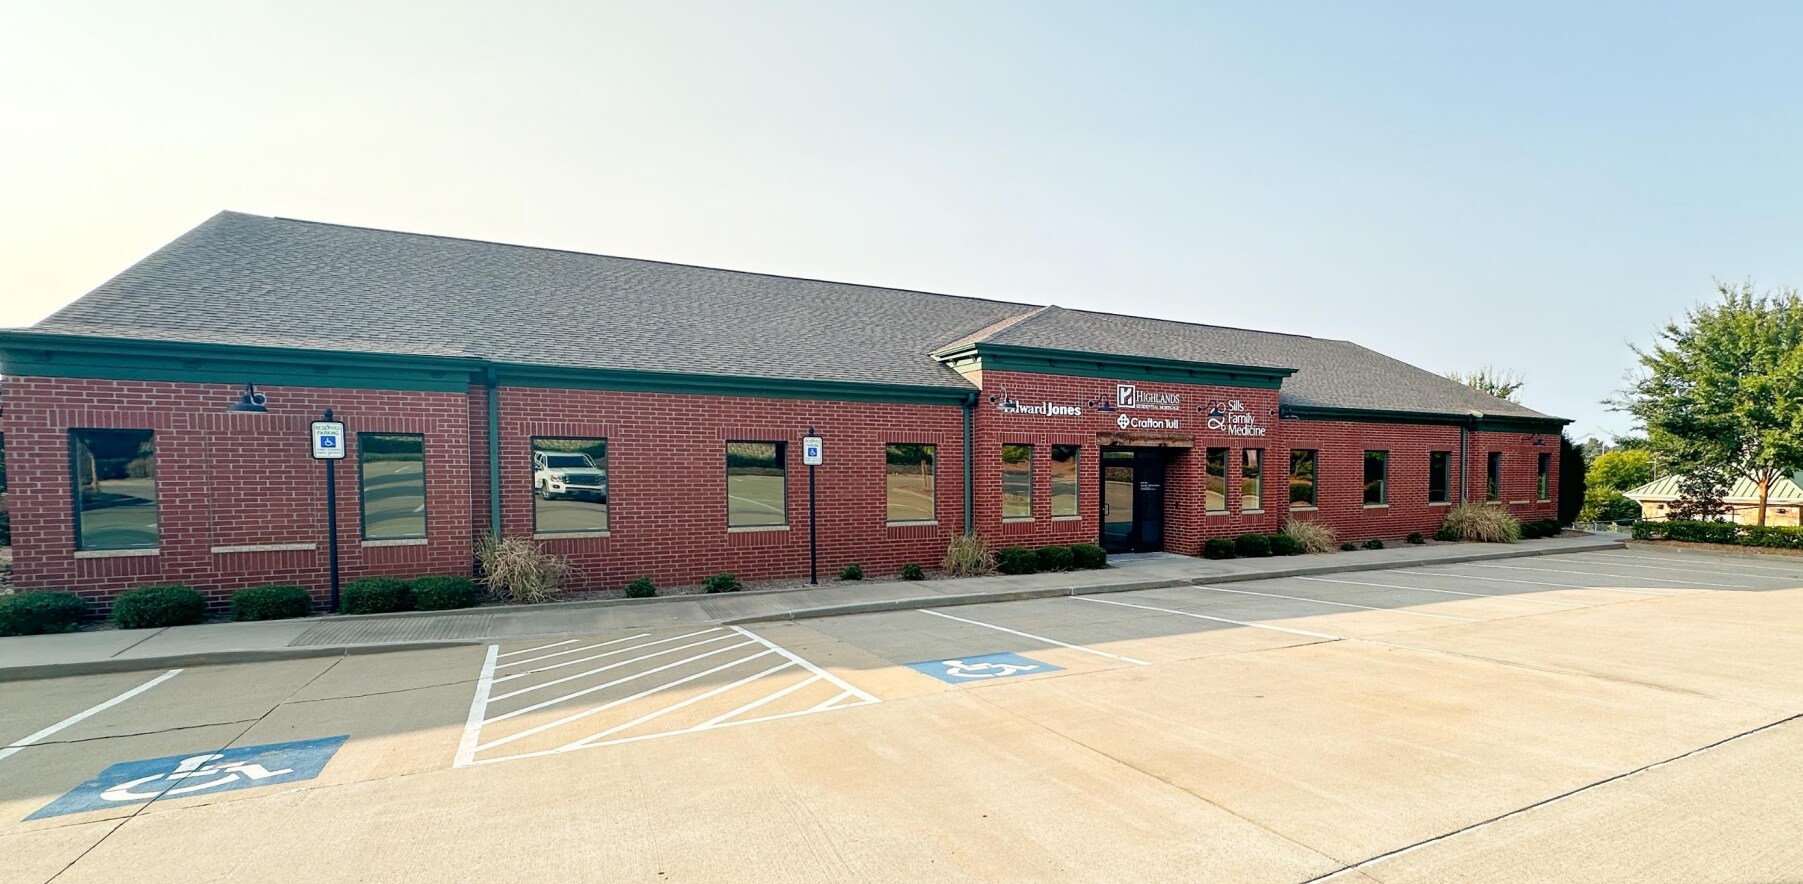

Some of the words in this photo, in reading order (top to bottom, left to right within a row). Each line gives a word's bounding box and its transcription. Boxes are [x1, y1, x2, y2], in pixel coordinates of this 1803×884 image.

[1136, 391, 1180, 404] HIGHLANDS
[1046, 402, 1082, 416] Jones
[1228, 400, 1245, 411] Sills
[1130, 417, 1164, 429] Crafton
[1164, 419, 1179, 429] Tull
[1228, 412, 1255, 427] Family
[1228, 424, 1266, 436] Medicine
